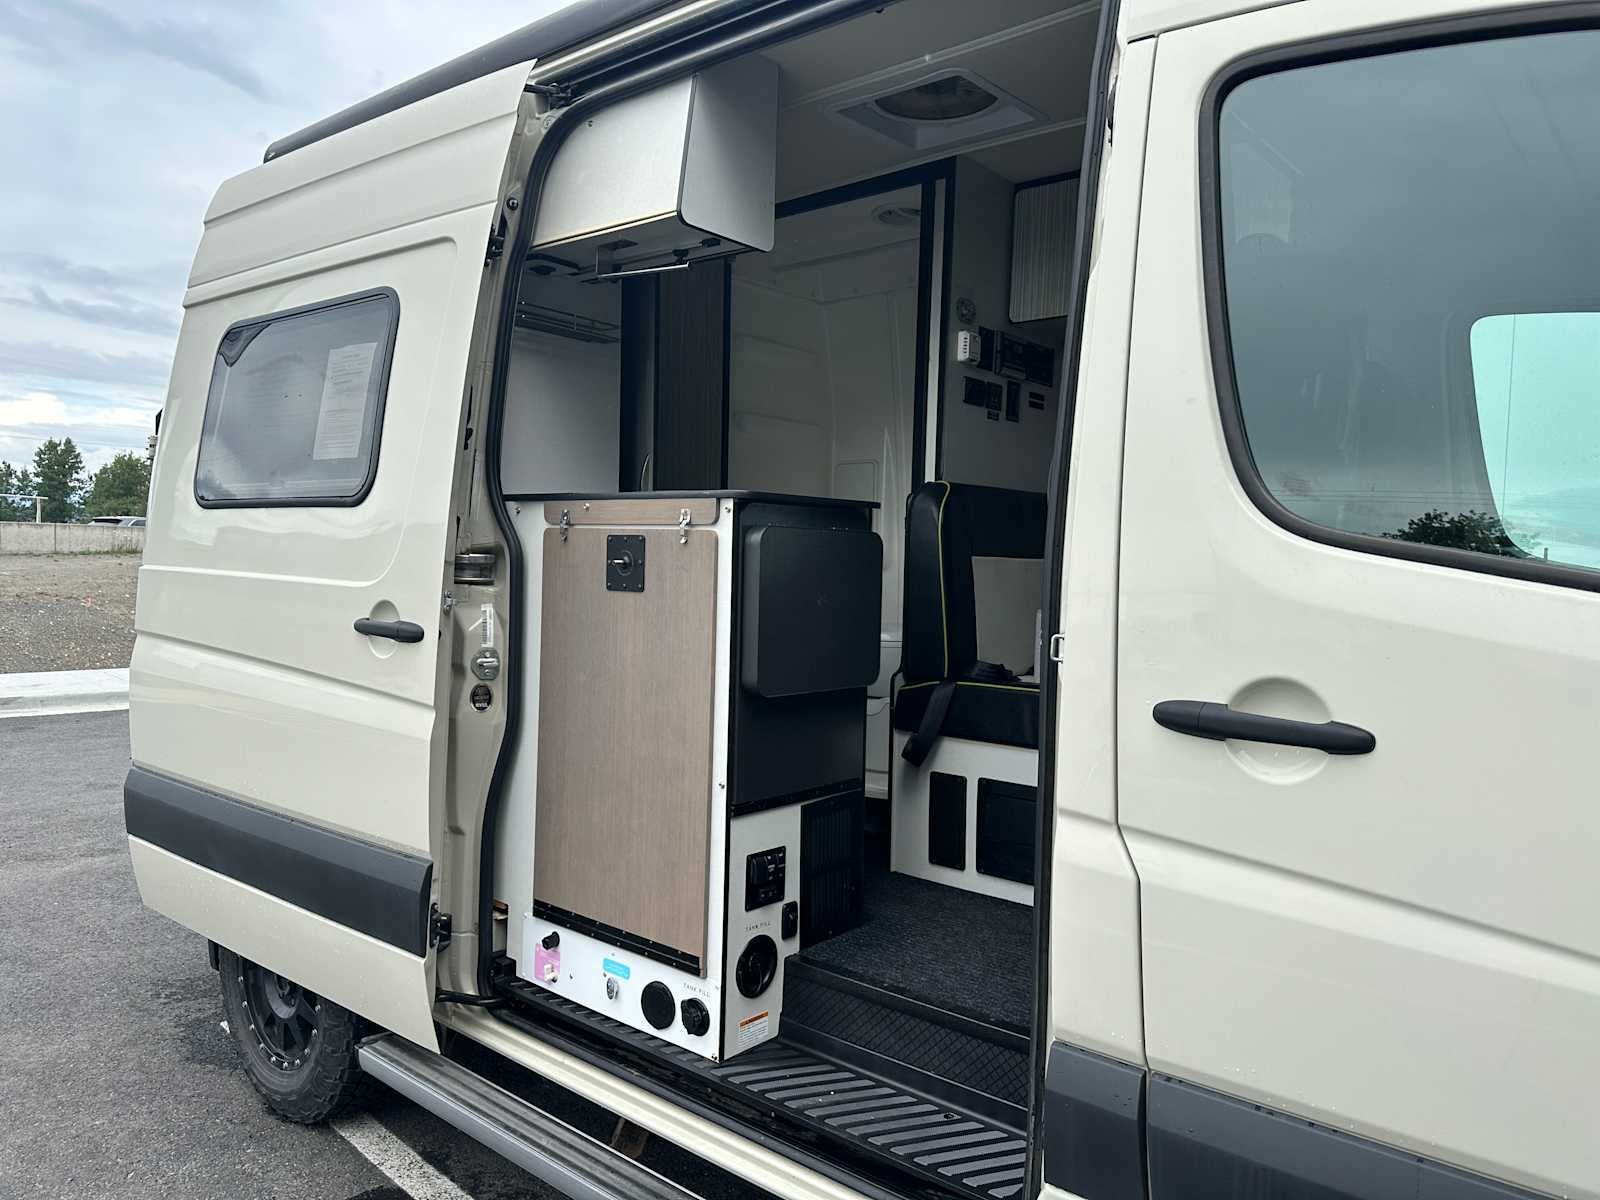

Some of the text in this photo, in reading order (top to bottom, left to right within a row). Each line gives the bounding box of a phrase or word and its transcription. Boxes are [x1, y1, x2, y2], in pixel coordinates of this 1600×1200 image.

[745, 923, 758, 931] TANK
[683, 982, 710, 998] TANK FILL
